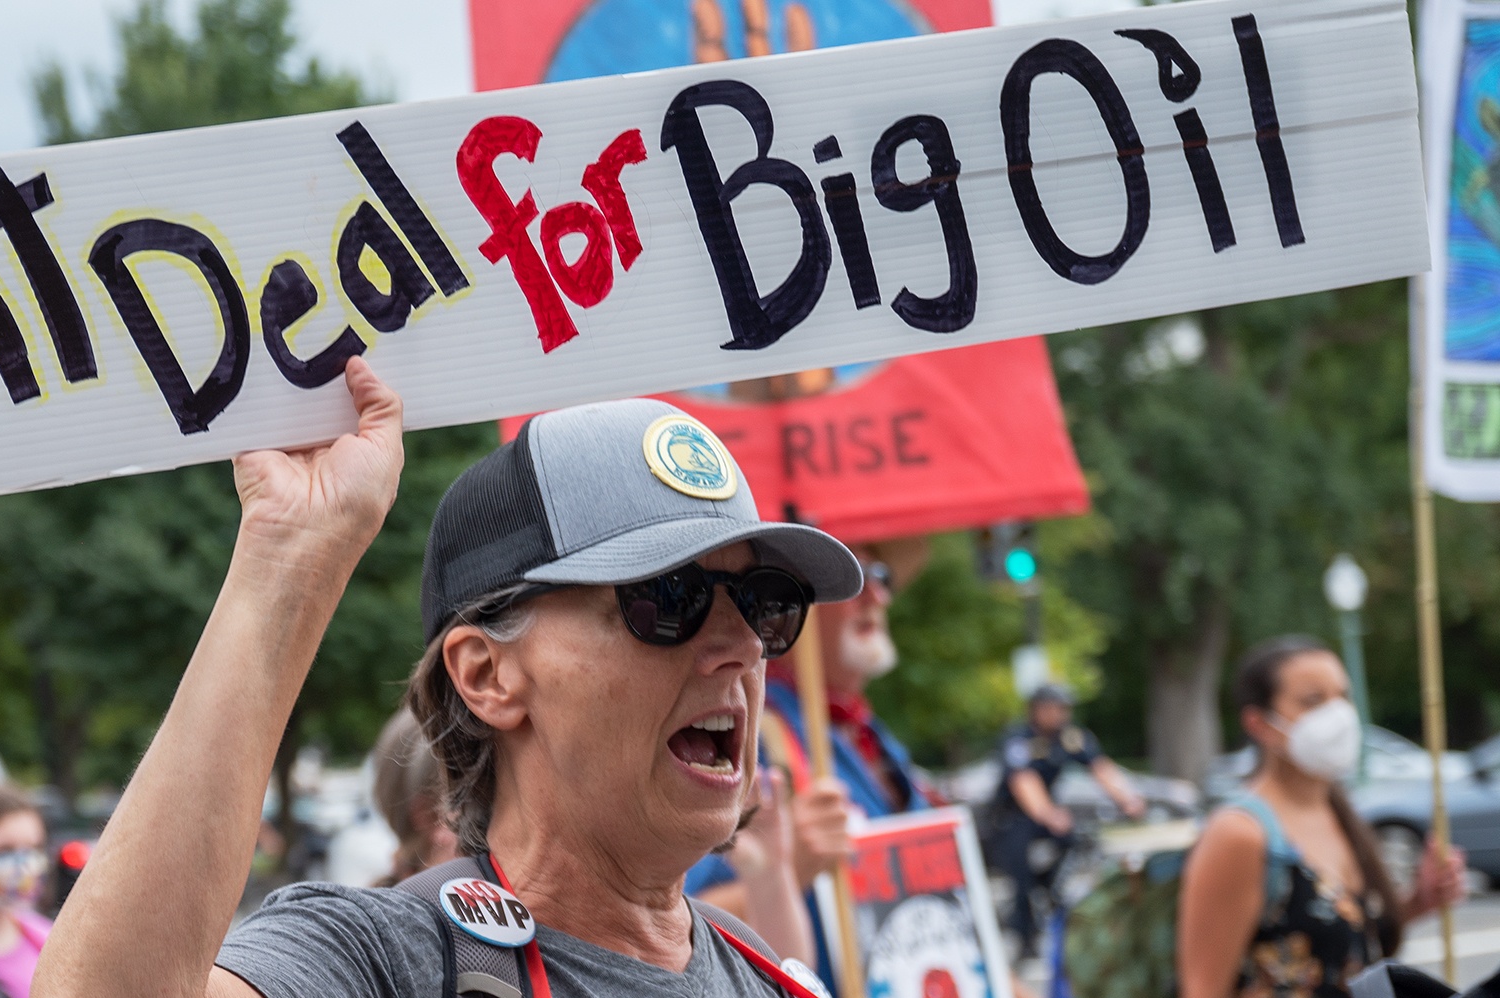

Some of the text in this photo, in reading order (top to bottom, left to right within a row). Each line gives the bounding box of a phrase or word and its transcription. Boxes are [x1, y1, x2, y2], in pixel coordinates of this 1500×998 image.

[89, 120, 470, 436] Deal
[455, 114, 648, 354] for
[660, 78, 977, 350] Big
[999, 12, 1306, 285] Oil
[780, 408, 931, 484] RISE
[444, 893, 531, 931] MVP
[452, 880, 501, 909] NO
